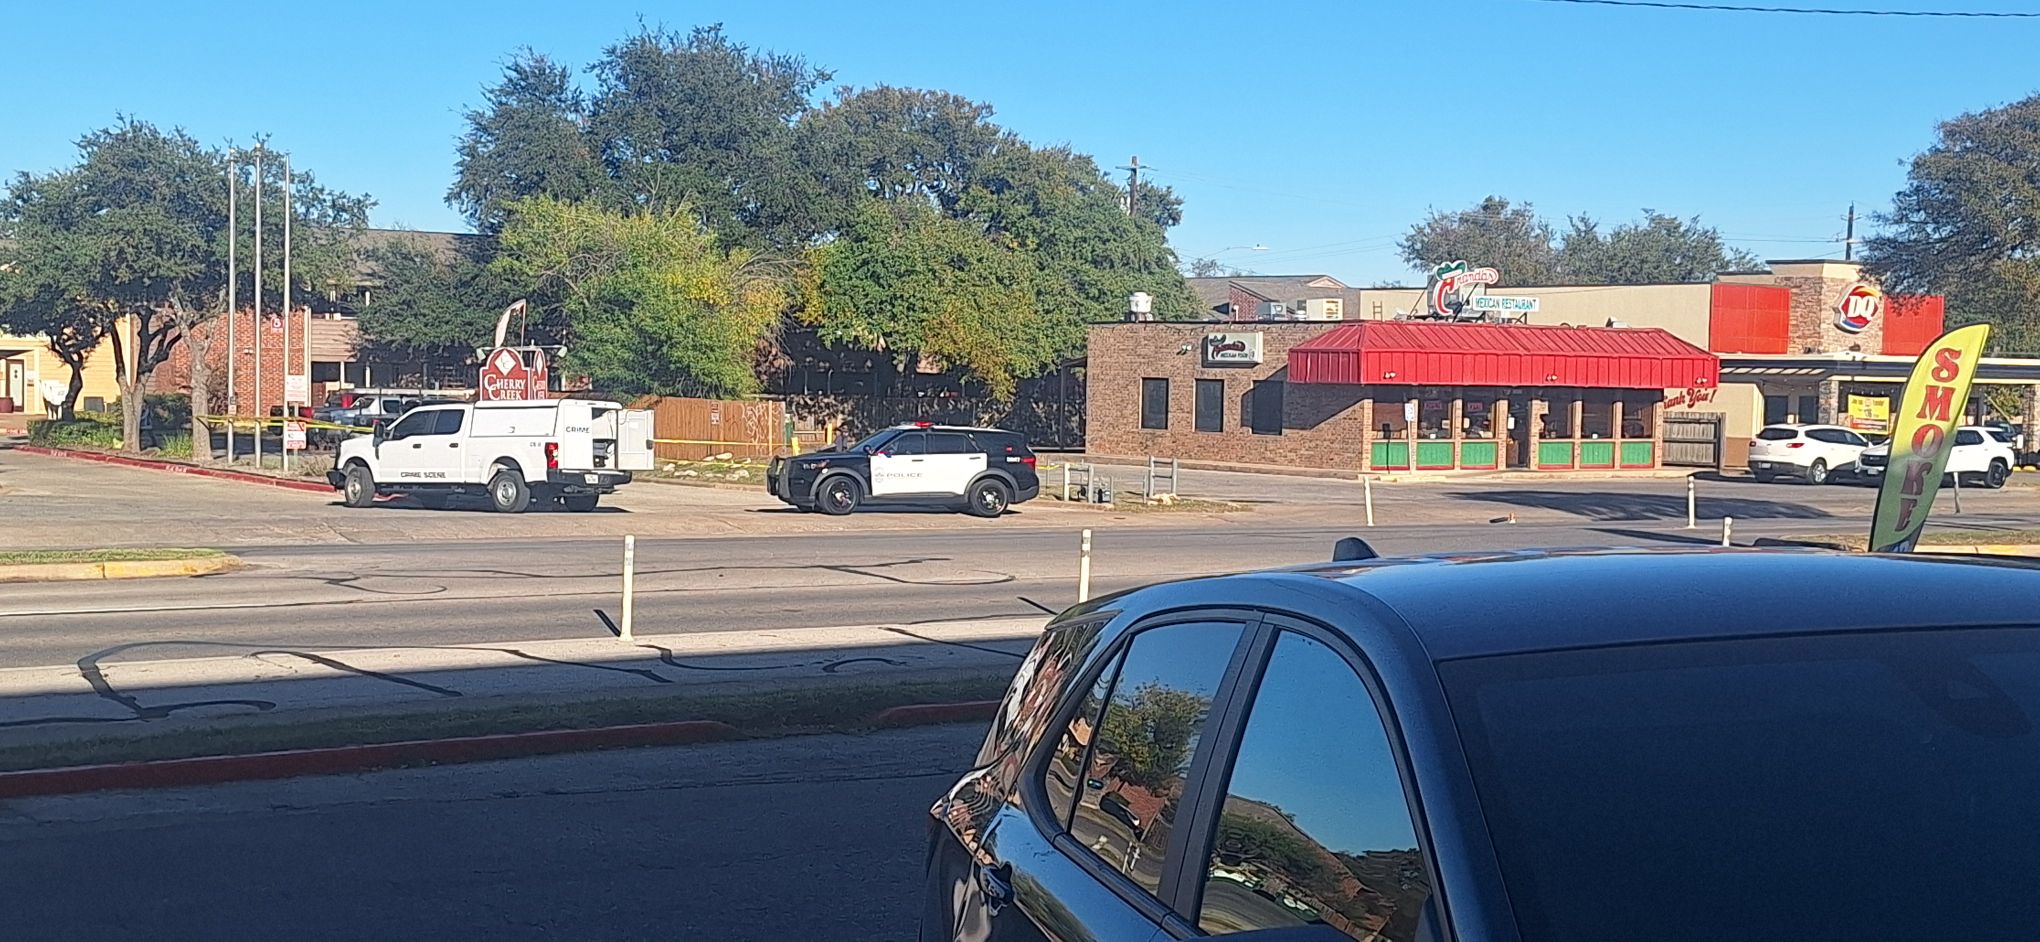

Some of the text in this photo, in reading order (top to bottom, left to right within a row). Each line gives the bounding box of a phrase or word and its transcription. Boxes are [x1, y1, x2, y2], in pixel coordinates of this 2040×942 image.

[1476, 297, 1499, 309] MEXICAN
[1847, 296, 1875, 320] DQ
[484, 374, 526, 390] CHERRY
[488, 384, 523, 400] CREEK
[1894, 347, 1962, 532] SMOKE
